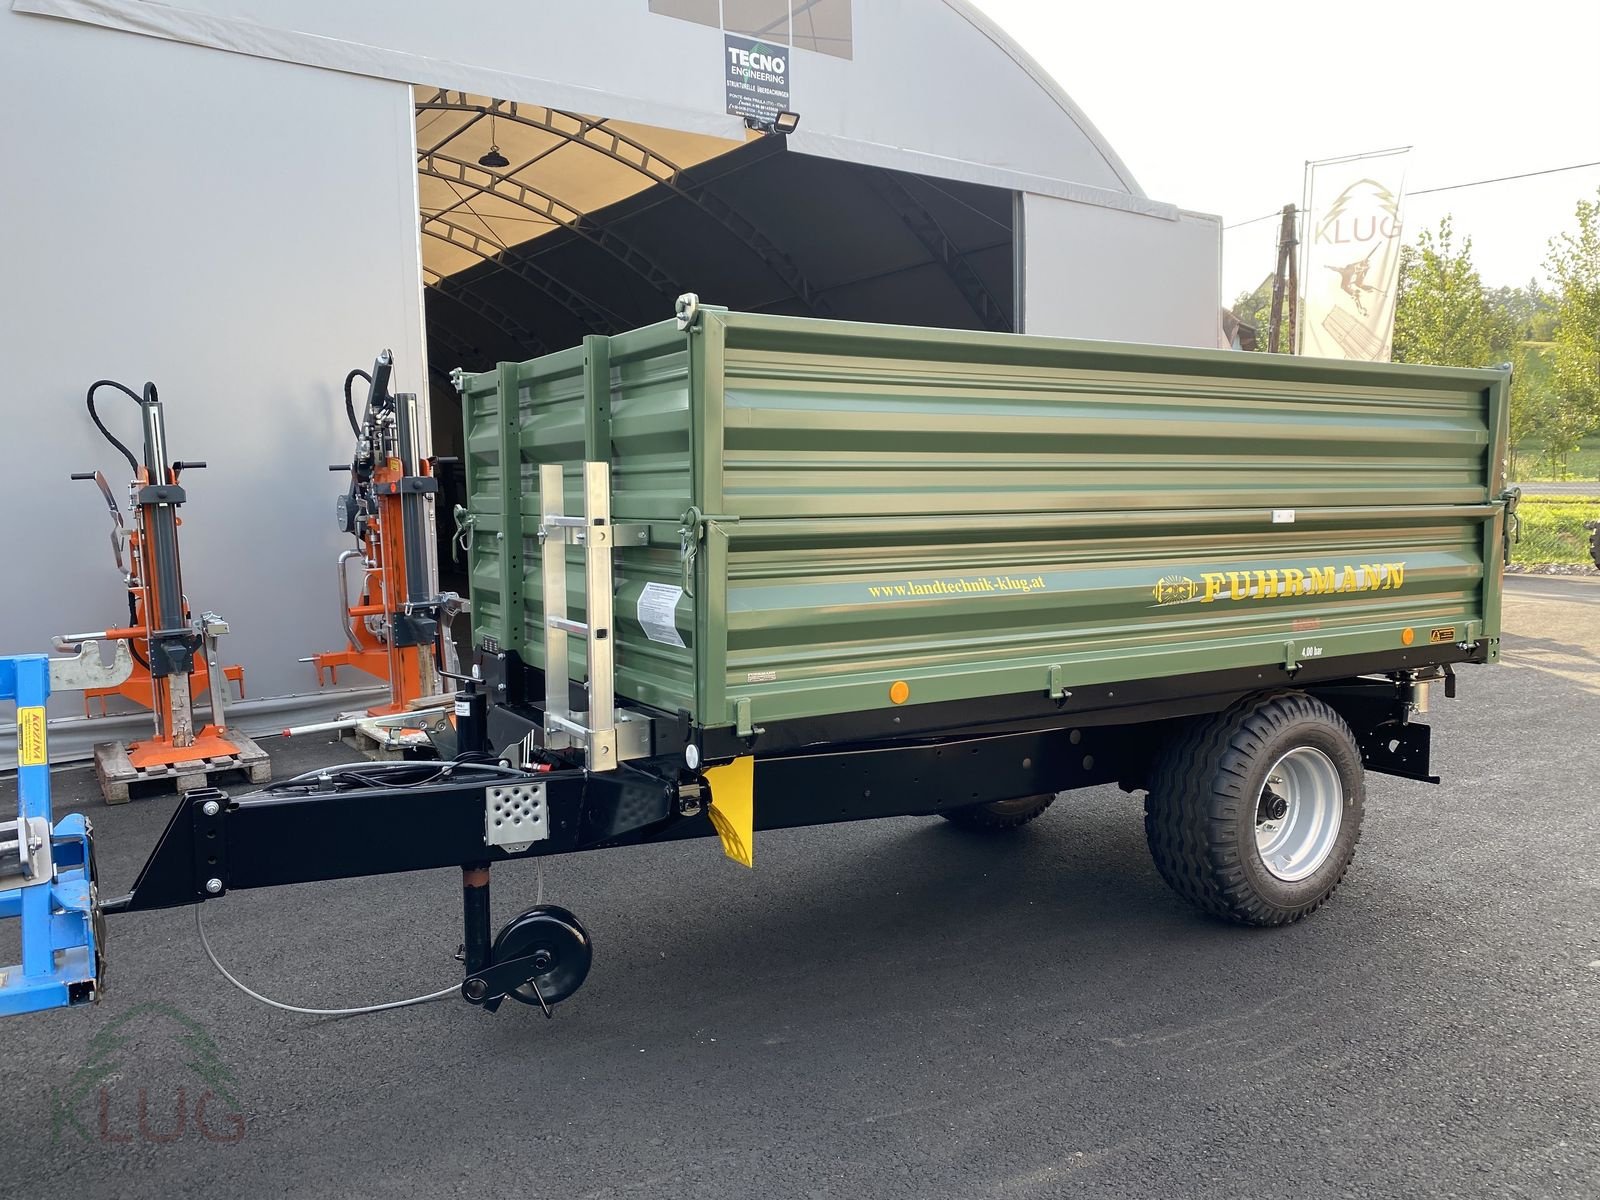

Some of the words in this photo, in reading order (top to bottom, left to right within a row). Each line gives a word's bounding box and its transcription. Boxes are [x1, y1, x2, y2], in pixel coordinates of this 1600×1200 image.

[731, 66, 785, 84] ENGINEERING
[1314, 215, 1402, 245] KLUG
[868, 575, 1046, 598] www.landtechnik-klug.at
[1200, 562, 1406, 602] FUHRMANN
[1314, 645, 1323, 656] bar
